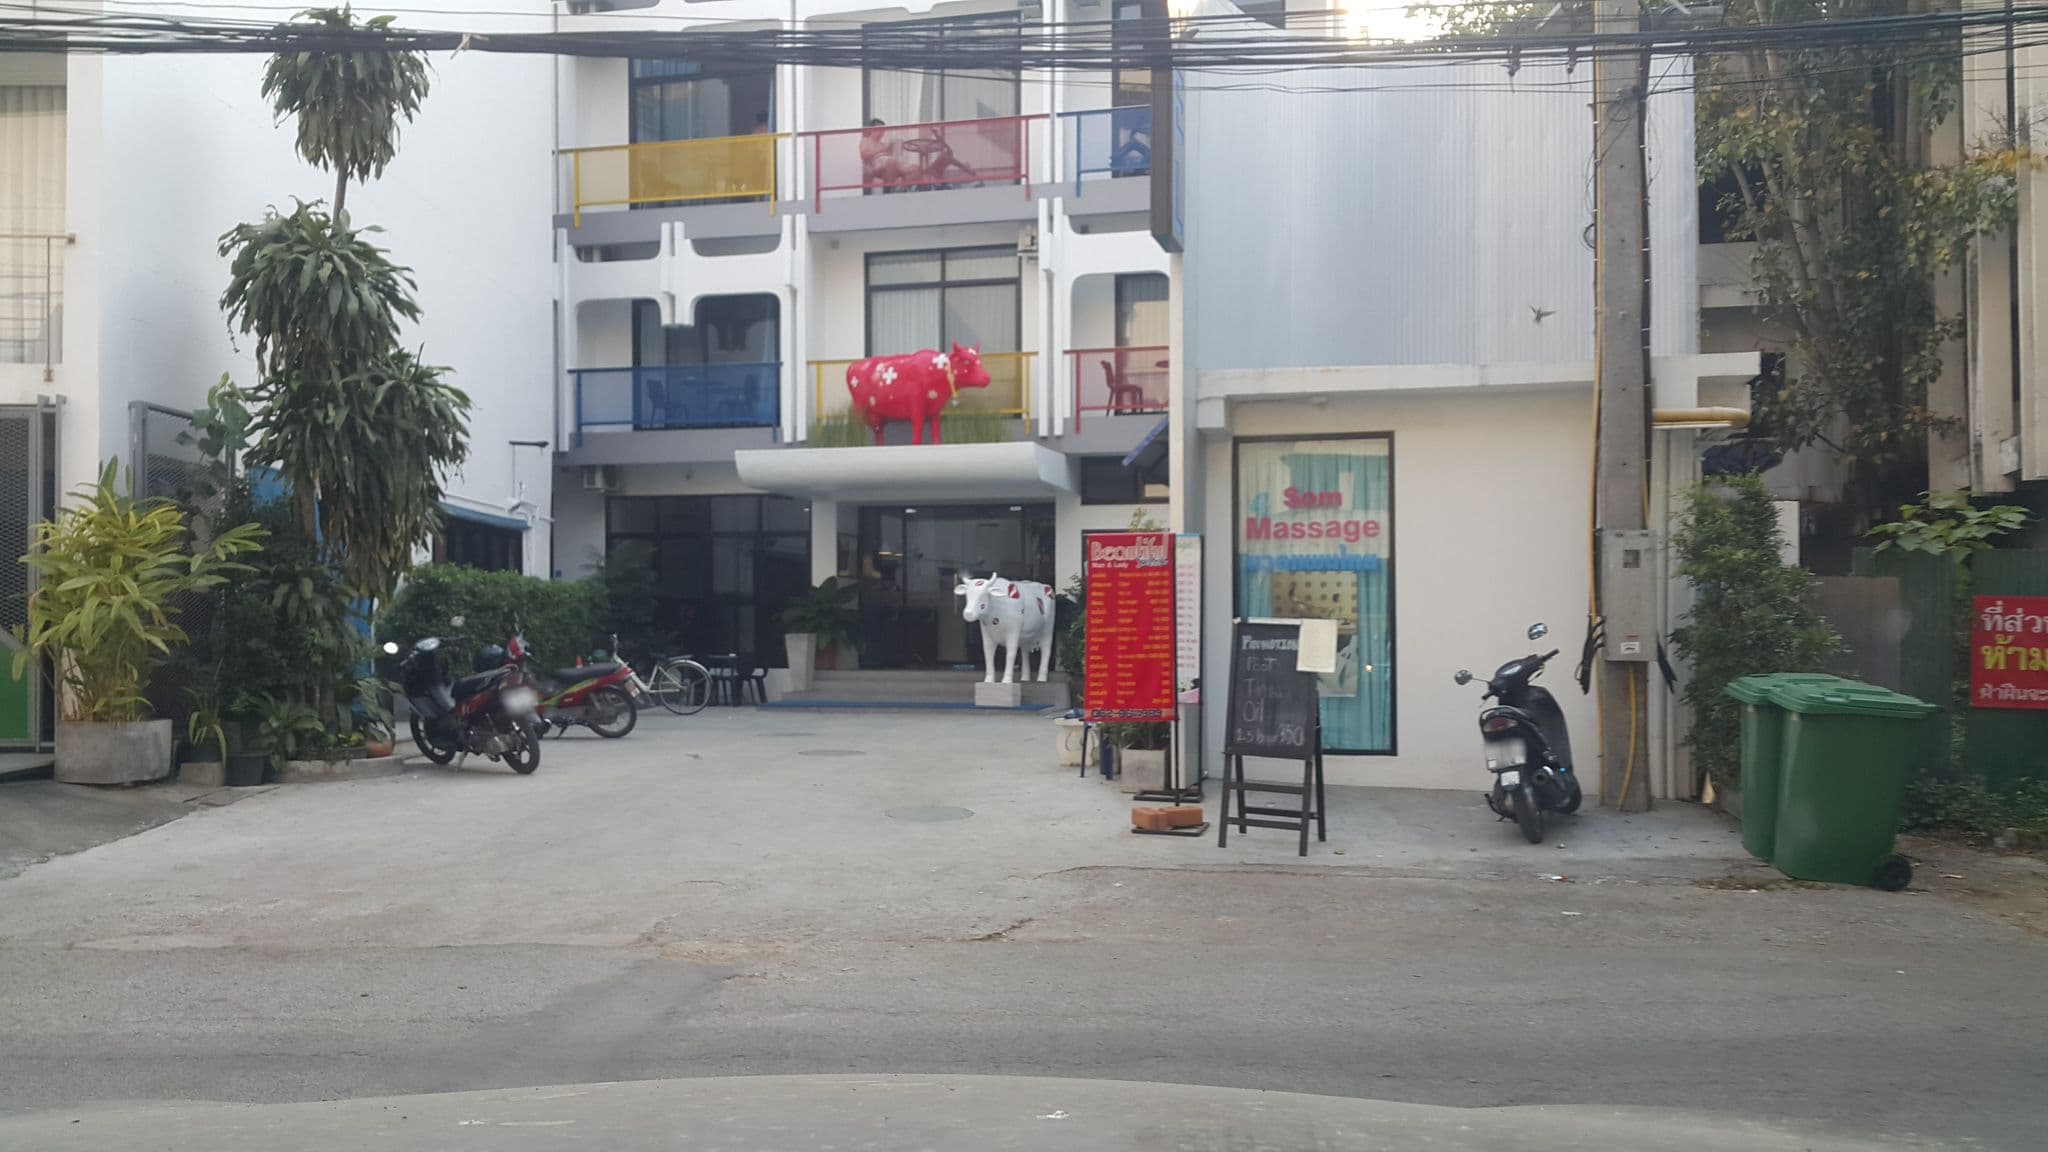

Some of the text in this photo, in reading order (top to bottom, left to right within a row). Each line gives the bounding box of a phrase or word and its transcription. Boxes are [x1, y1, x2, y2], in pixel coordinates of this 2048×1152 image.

[1283, 486, 1343, 510] Som
[1246, 516, 1380, 543] Massage
[1091, 532, 1169, 561] Beautiful
[1242, 698, 1265, 722] Oil
